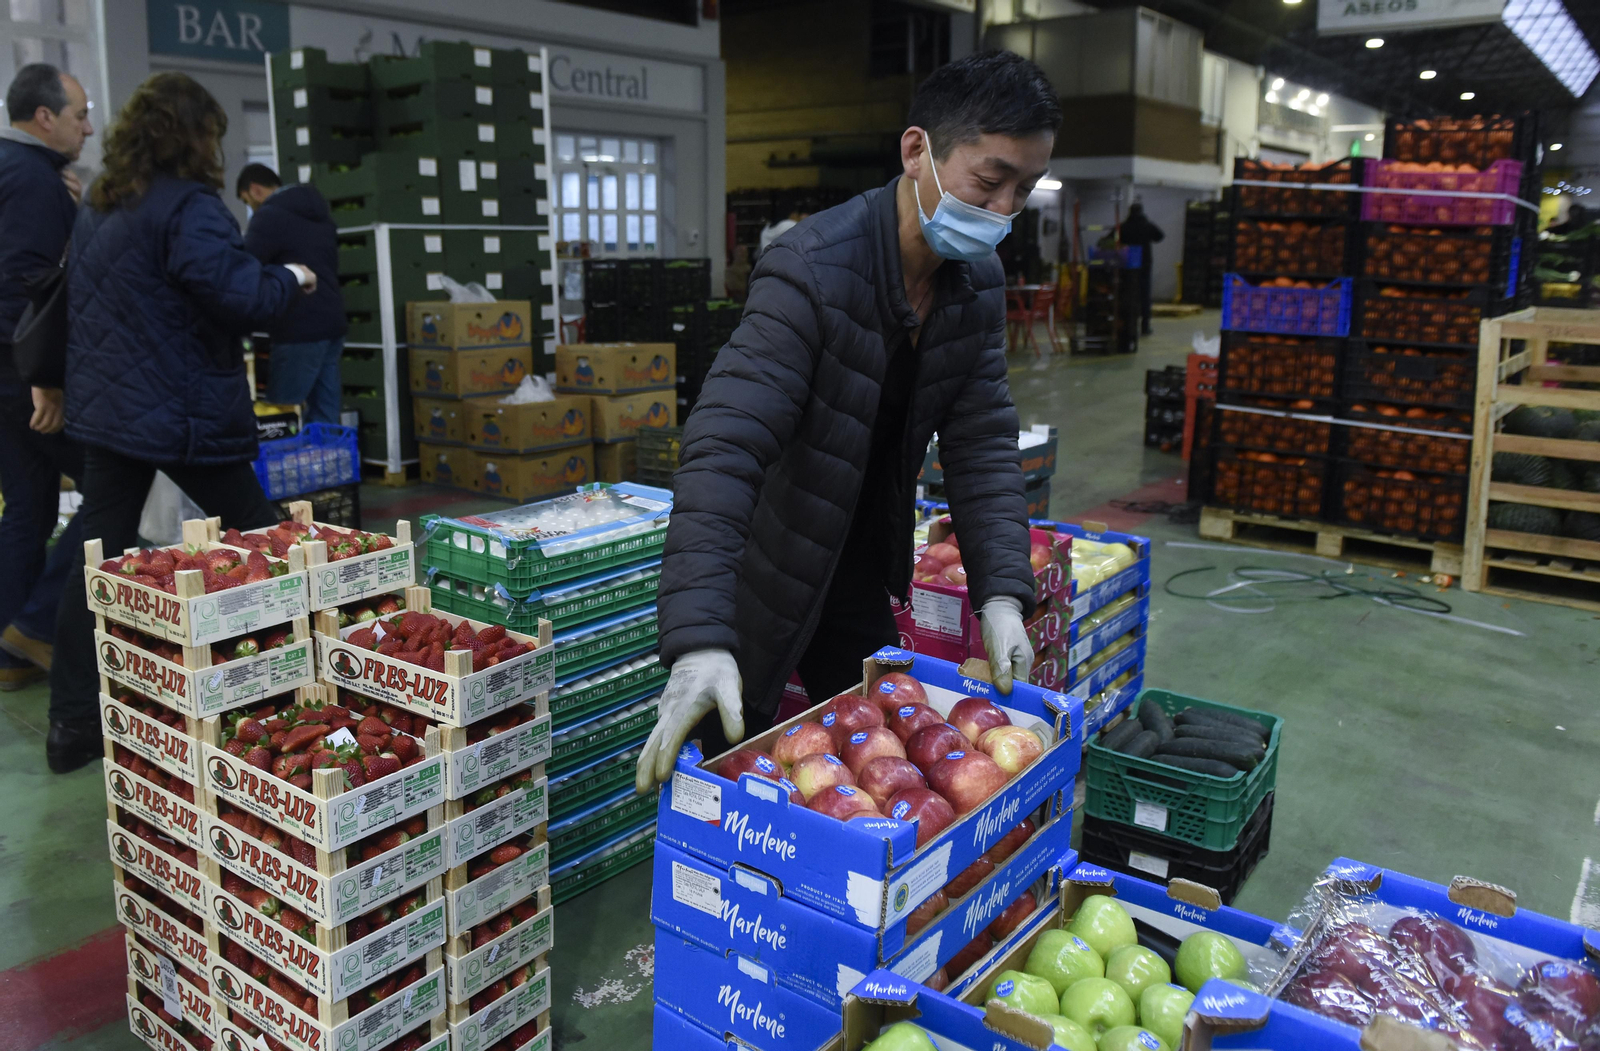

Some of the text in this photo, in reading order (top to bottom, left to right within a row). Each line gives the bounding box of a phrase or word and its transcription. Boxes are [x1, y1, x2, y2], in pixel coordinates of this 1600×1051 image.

[177, 5, 265, 51] BAR
[548, 54, 648, 100] Central
[117, 583, 181, 626] FRES-LUZ
[126, 651, 186, 697] FRES-LUZ
[877, 650, 902, 658] Marlene
[364, 658, 448, 706] FRES-LUZ
[962, 679, 990, 695] Marlene
[129, 715, 188, 764] FRES-LUZ
[136, 782, 198, 835] FRES-LUZ
[240, 769, 316, 829] FRES-LUZ
[724, 810, 796, 861] Marlene
[973, 796, 1020, 853] Marlene
[138, 845, 201, 901] FRES-LUZ
[241, 840, 318, 903] FRES-LUZ
[801, 883, 823, 896] PRODUCT
[833, 896, 846, 905] ITALY
[1075, 868, 1107, 878] Marlene
[718, 899, 787, 951] Marlene
[963, 880, 1010, 939] Marlene
[1174, 904, 1206, 923] Marlene
[1457, 907, 1498, 929] Marlene
[146, 908, 207, 967] FRES-LUZ
[244, 912, 320, 979] FRES-LUZ
[792, 972, 815, 985] PRODUCT
[824, 987, 837, 996] ITALY
[865, 982, 907, 996] Marlene
[1202, 992, 1246, 1013] Marlene
[244, 983, 321, 1051] FRES-LUZ
[717, 984, 785, 1039] Marlene
